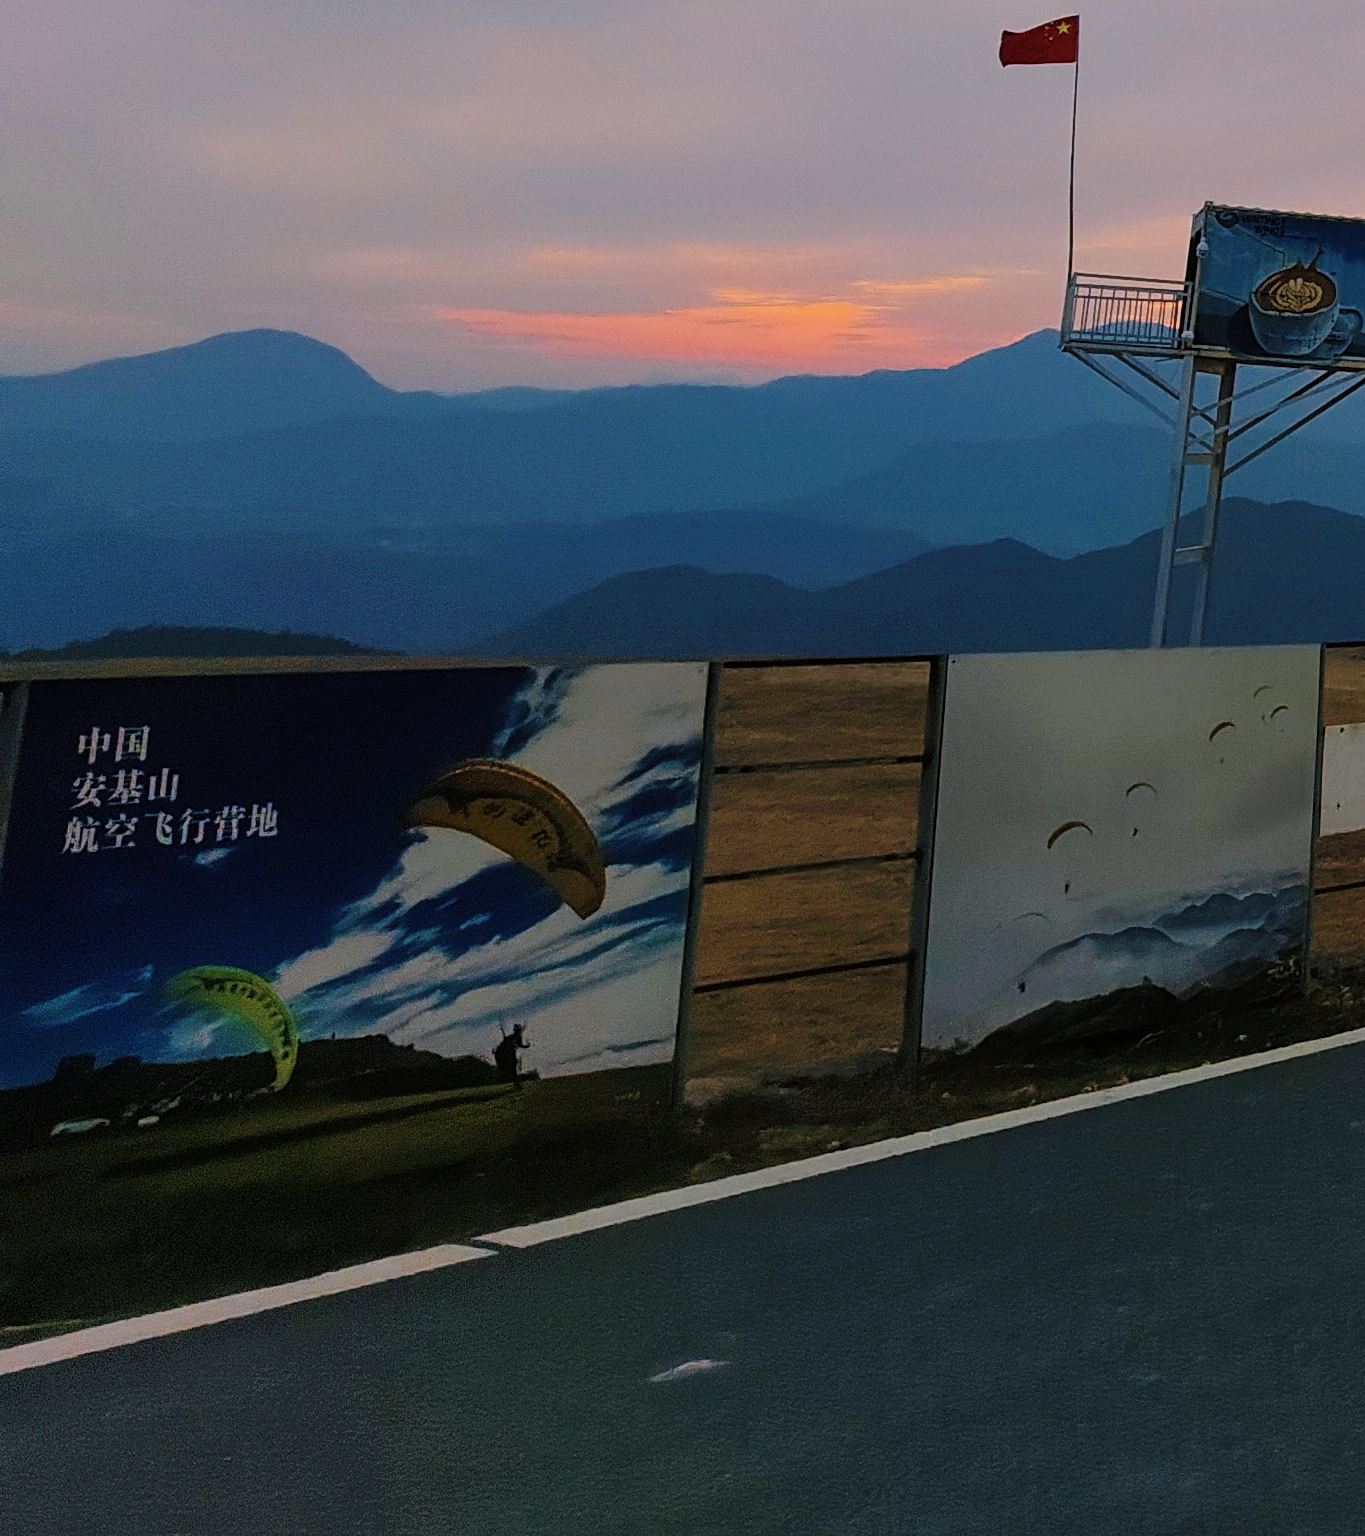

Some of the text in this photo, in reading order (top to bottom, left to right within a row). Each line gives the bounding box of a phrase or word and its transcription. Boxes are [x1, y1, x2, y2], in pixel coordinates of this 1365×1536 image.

[77, 724, 151, 765] 中国
[68, 767, 180, 810] 安基山
[61, 802, 279, 855] 航空飞行营地
